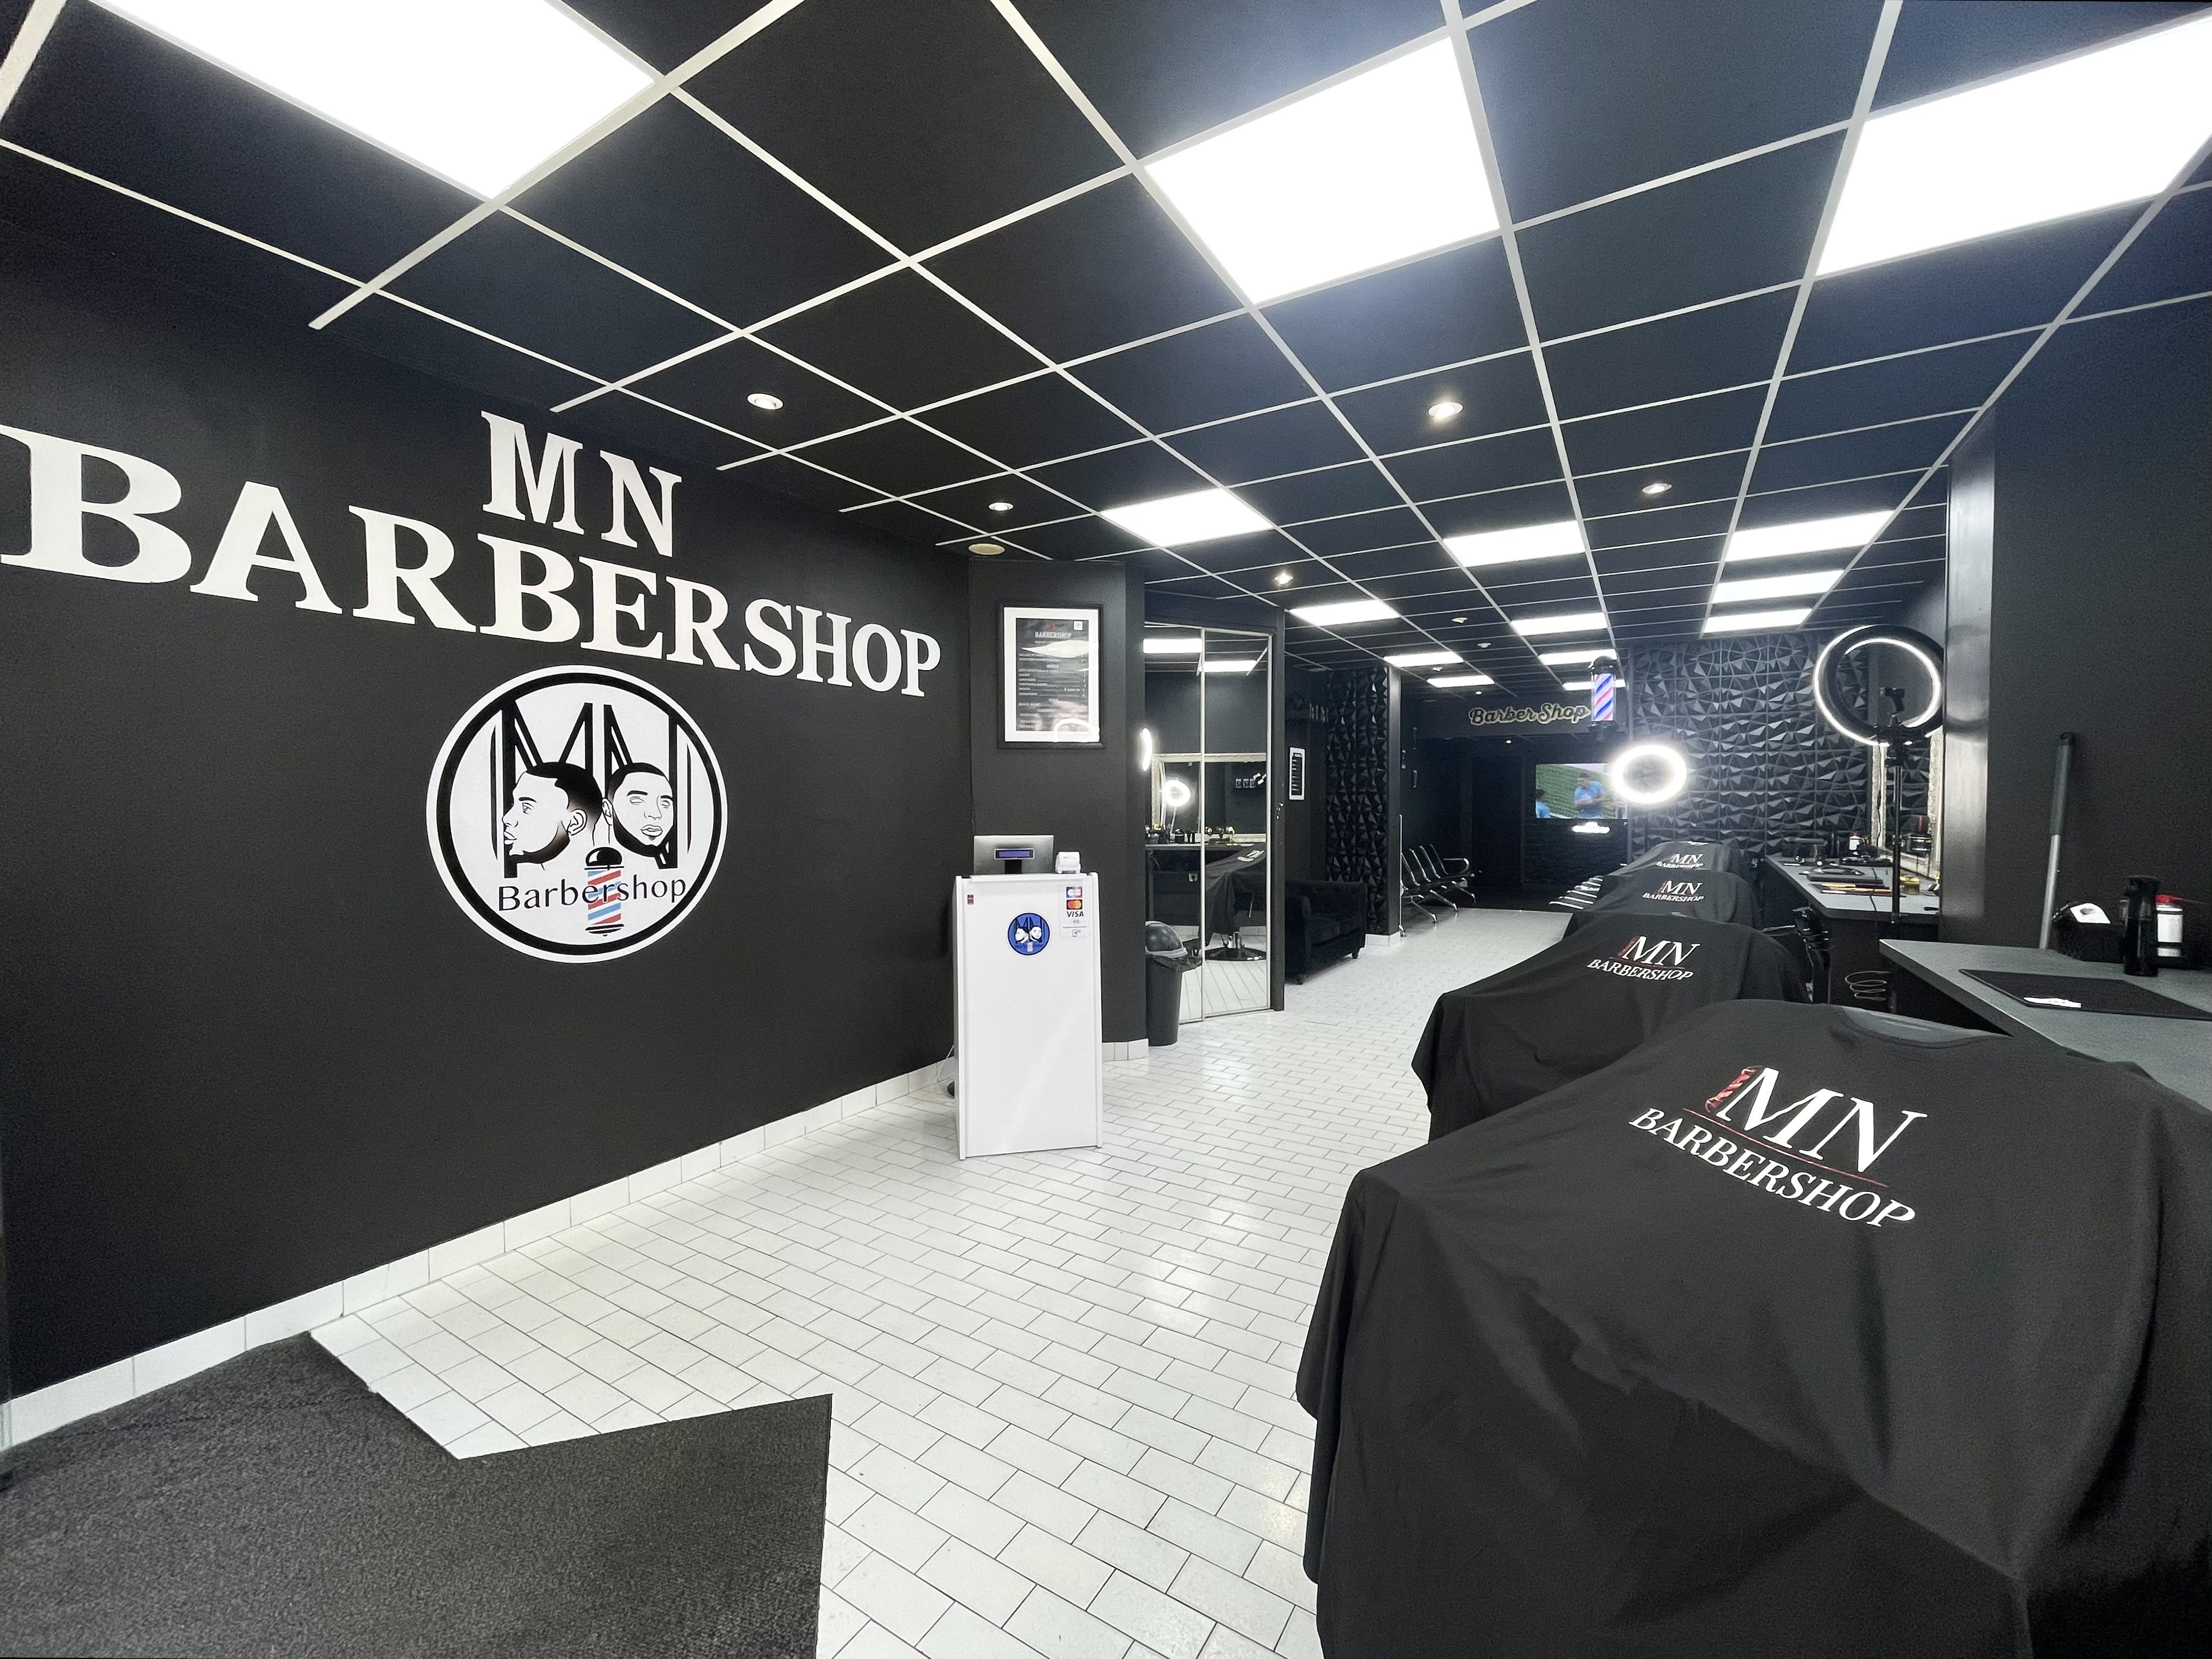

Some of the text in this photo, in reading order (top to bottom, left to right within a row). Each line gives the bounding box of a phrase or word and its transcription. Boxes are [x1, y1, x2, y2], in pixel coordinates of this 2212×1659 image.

[481, 411, 681, 557] MN
[0, 425, 941, 697] BARBERSHOP
[1469, 702, 1591, 726] Barber Shop
[1670, 854, 1704, 865] MN
[499, 874, 686, 911] Barbershop
[1642, 892, 1704, 902] BARBERSHOP
[1661, 880, 1703, 895] MN
[1622, 936, 1701, 966] MN
[1587, 959, 1694, 980] BARBERSHOP
[1716, 1067, 1928, 1173] MN
[1629, 1107, 1916, 1227] BARBERSHOP
